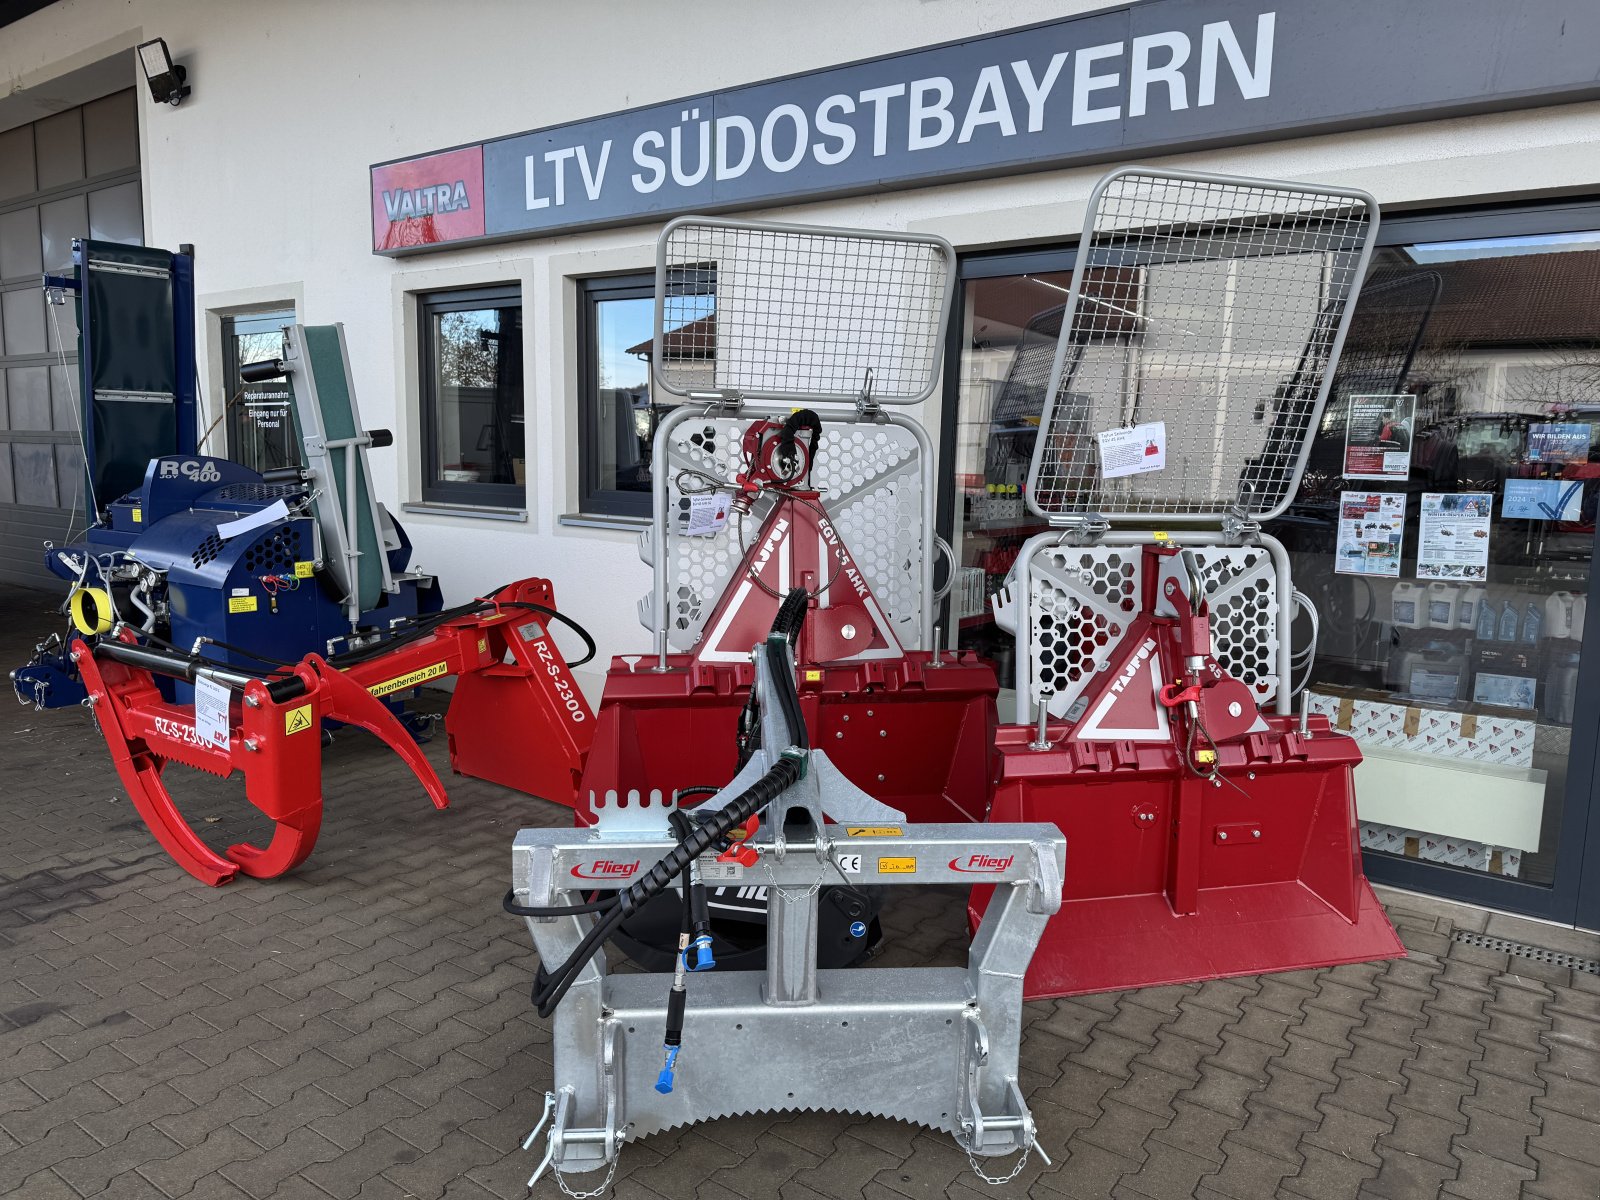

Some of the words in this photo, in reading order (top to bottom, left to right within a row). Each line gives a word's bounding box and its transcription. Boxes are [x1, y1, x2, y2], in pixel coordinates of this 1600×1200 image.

[524, 140, 612, 211] LTV
[631, 11, 1277, 194] SÜDOSTBAYERN
[382, 180, 470, 222] VALTRA
[248, 409, 270, 420] Eingang
[280, 408, 288, 417] für
[257, 419, 280, 428] Personal
[160, 460, 216, 476] RCA
[189, 470, 221, 482] 400
[746, 518, 789, 579] TAJFUN
[817, 518, 839, 546] EGV
[845, 567, 868, 598] AHK
[427, 668, 437, 677] 20
[438, 663, 446, 673] M
[1111, 637, 1157, 693] TAJFUN
[1208, 663, 1223, 679] 45
[533, 640, 585, 722] RZ-S-2300
[591, 860, 640, 876] Fliegl
[968, 854, 1015, 871] Fliegl
